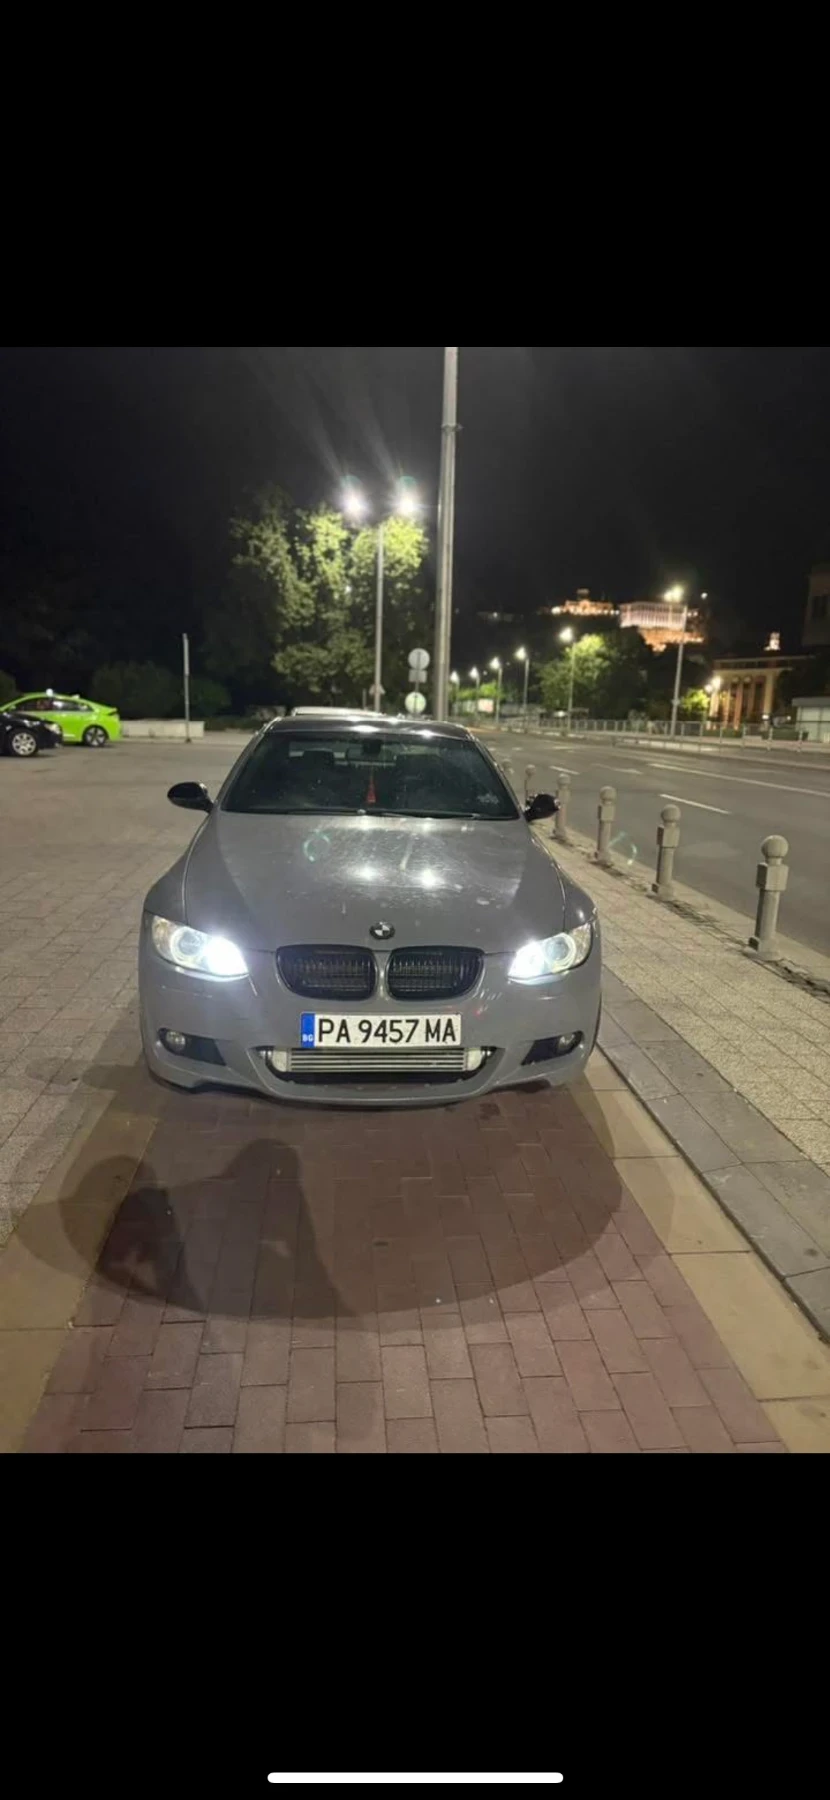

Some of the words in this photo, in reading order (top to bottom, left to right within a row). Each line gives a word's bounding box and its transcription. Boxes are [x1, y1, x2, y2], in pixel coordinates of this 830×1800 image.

[302, 1033, 314, 1042] BG
[318, 1018, 351, 1043] PA
[358, 1019, 419, 1043] 9457
[425, 1018, 456, 1043] MA
